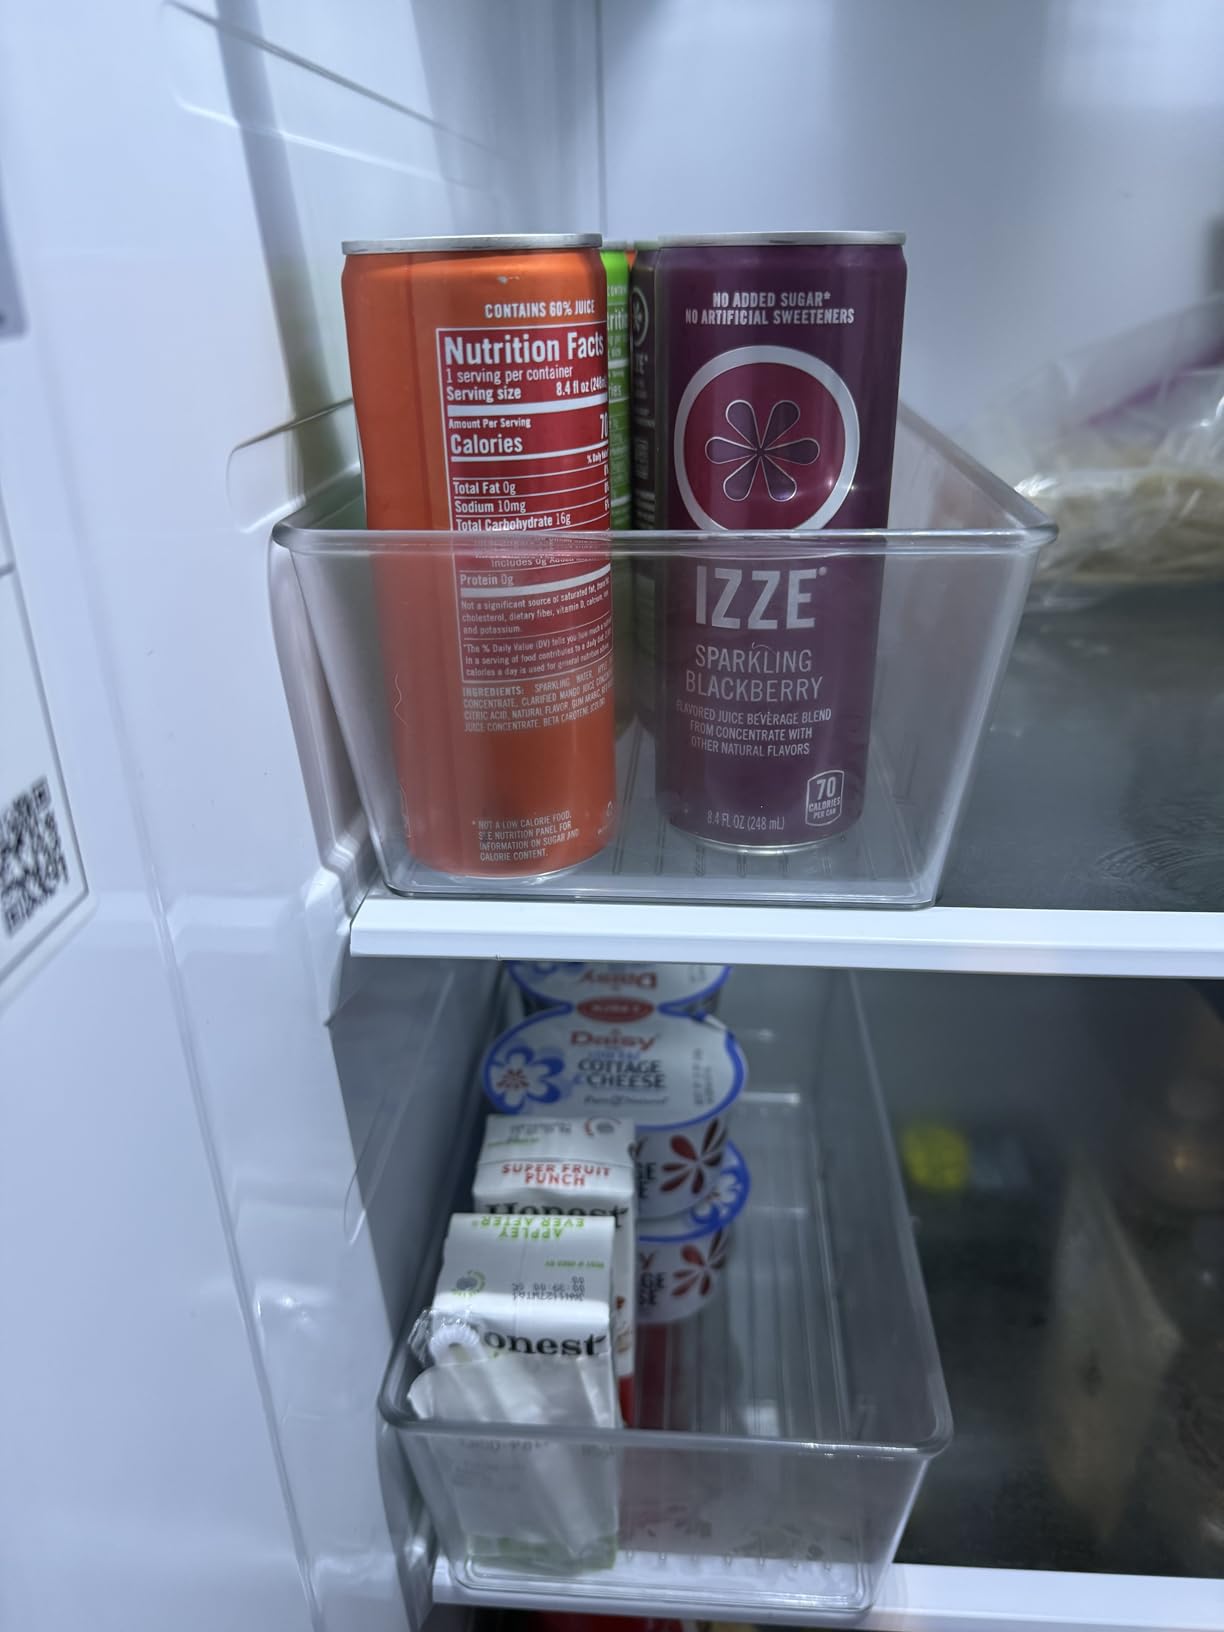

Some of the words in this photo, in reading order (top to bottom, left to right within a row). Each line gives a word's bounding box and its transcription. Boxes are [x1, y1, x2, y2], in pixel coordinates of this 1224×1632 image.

[713, 292, 729, 307] NO
[733, 292, 775, 307] ADDED
[485, 303, 546, 319] CONTAINS
[550, 301, 572, 317] 60%
[575, 300, 595, 315] JUICE
[686, 309, 698, 324] NO
[701, 310, 768, 324] ARTIFICIAL
[773, 308, 854, 324] SWEETENERS
[445, 334, 559, 365] Nutrition
[567, 332, 604, 360] Facts
[446, 368, 452, 383] 1
[457, 368, 500, 384] serving
[505, 369, 522, 384] per
[526, 366, 573, 381] container
[447, 386, 494, 403] Serving
[497, 386, 521, 400] size
[556, 381, 570, 396] 8.4
[574, 380, 579, 394] fl
[580, 381, 589, 393] oz
[449, 419, 480, 429] Amount
[483, 418, 496, 428] Per
[500, 418, 531, 428] Serving
[451, 434, 523, 454] Calories
[453, 482, 480, 494] Total
[482, 481, 500, 494] Fat
[503, 481, 516, 496] 0g
[455, 500, 494, 512] Sodium
[498, 500, 526, 514] 10mg
[456, 519, 482, 531] Total
[486, 516, 552, 531] Carbohydrate
[556, 512, 571, 525] 16g
[460, 574, 498, 586] Protein
[501, 574, 514, 586] 0g
[461, 600, 474, 610] Not
[476, 602, 482, 610] a
[484, 598, 526, 612] significant
[528, 597, 551, 608] source
[560, 588, 588, 602] saturated
[696, 566, 822, 630] IZZE
[462, 613, 507, 622] cholesterol,
[510, 612, 534, 622] dietary
[556, 602, 579, 615] vitamin
[464, 626, 478, 634] and
[482, 644, 490, 653] %
[492, 644, 512, 654] Daily
[514, 642, 534, 651] Value
[536, 638, 550, 650] (DV)
[567, 634, 576, 645] you
[466, 656, 472, 664] in
[482, 656, 510, 666] serving
[512, 654, 518, 663] of
[522, 652, 536, 662] food
[696, 644, 812, 674] SPARKLING
[466, 667, 496, 676] calories
[504, 667, 518, 676] day
[528, 663, 544, 673] used
[464, 686, 524, 698] INGREDIENTS:
[535, 678, 570, 692] SPARKLING
[686, 670, 823, 702] BLACKBERRY
[522, 693, 556, 706] CLARIFIED
[560, 687, 580, 700] MANGO
[464, 712, 488, 721] CITRIC
[512, 708, 542, 719] NATURAL
[676, 700, 716, 721] FLAVORED
[718, 710, 744, 725] JUICE
[747, 711, 798, 726] BEVERAGE
[802, 708, 832, 723] BLEND
[464, 723, 484, 732] JUICE
[690, 720, 714, 737] FROM
[716, 725, 785, 741] CONCENTRATE
[788, 727, 812, 740] WITH
[691, 736, 719, 752] OTHER
[721, 742, 765, 757] NATURAL
[767, 742, 810, 756] FLAVORS
[816, 776, 836, 800] 70
[809, 796, 840, 812] CALORIES
[496, 820, 500, 830] A
[502, 819, 518, 829] LOW
[520, 816, 550, 828] CALORIE
[553, 810, 572, 822] FOOD.
[707, 810, 720, 825] 8.4
[722, 813, 732, 828] FL
[733, 816, 744, 830] OZ
[747, 815, 766, 831] (248
[814, 811, 824, 819] PER
[478, 832, 492, 840] SE
[495, 829, 534, 840] NUTRITION
[536, 826, 558, 838] PANEL
[560, 821, 572, 832] FOR
[480, 841, 528, 851] INFORMATION
[531, 838, 540, 848] ON
[544, 834, 566, 846] SUGAR
[567, 830, 579, 841] AND
[480, 852, 510, 862] CALORIE
[570, 1029, 656, 1052] Daisy
[578, 1058, 661, 1073] COTTAGE
[587, 1073, 666, 1089] CHEESE
[502, 1163, 556, 1176] SUPER
[561, 1164, 611, 1177] FRUIT
[524, 1173, 586, 1187] PUNCH
[538, 1216, 585, 1228] EVER
[500, 1227, 562, 1240] APPLEY
[483, 1330, 608, 1357] onest
